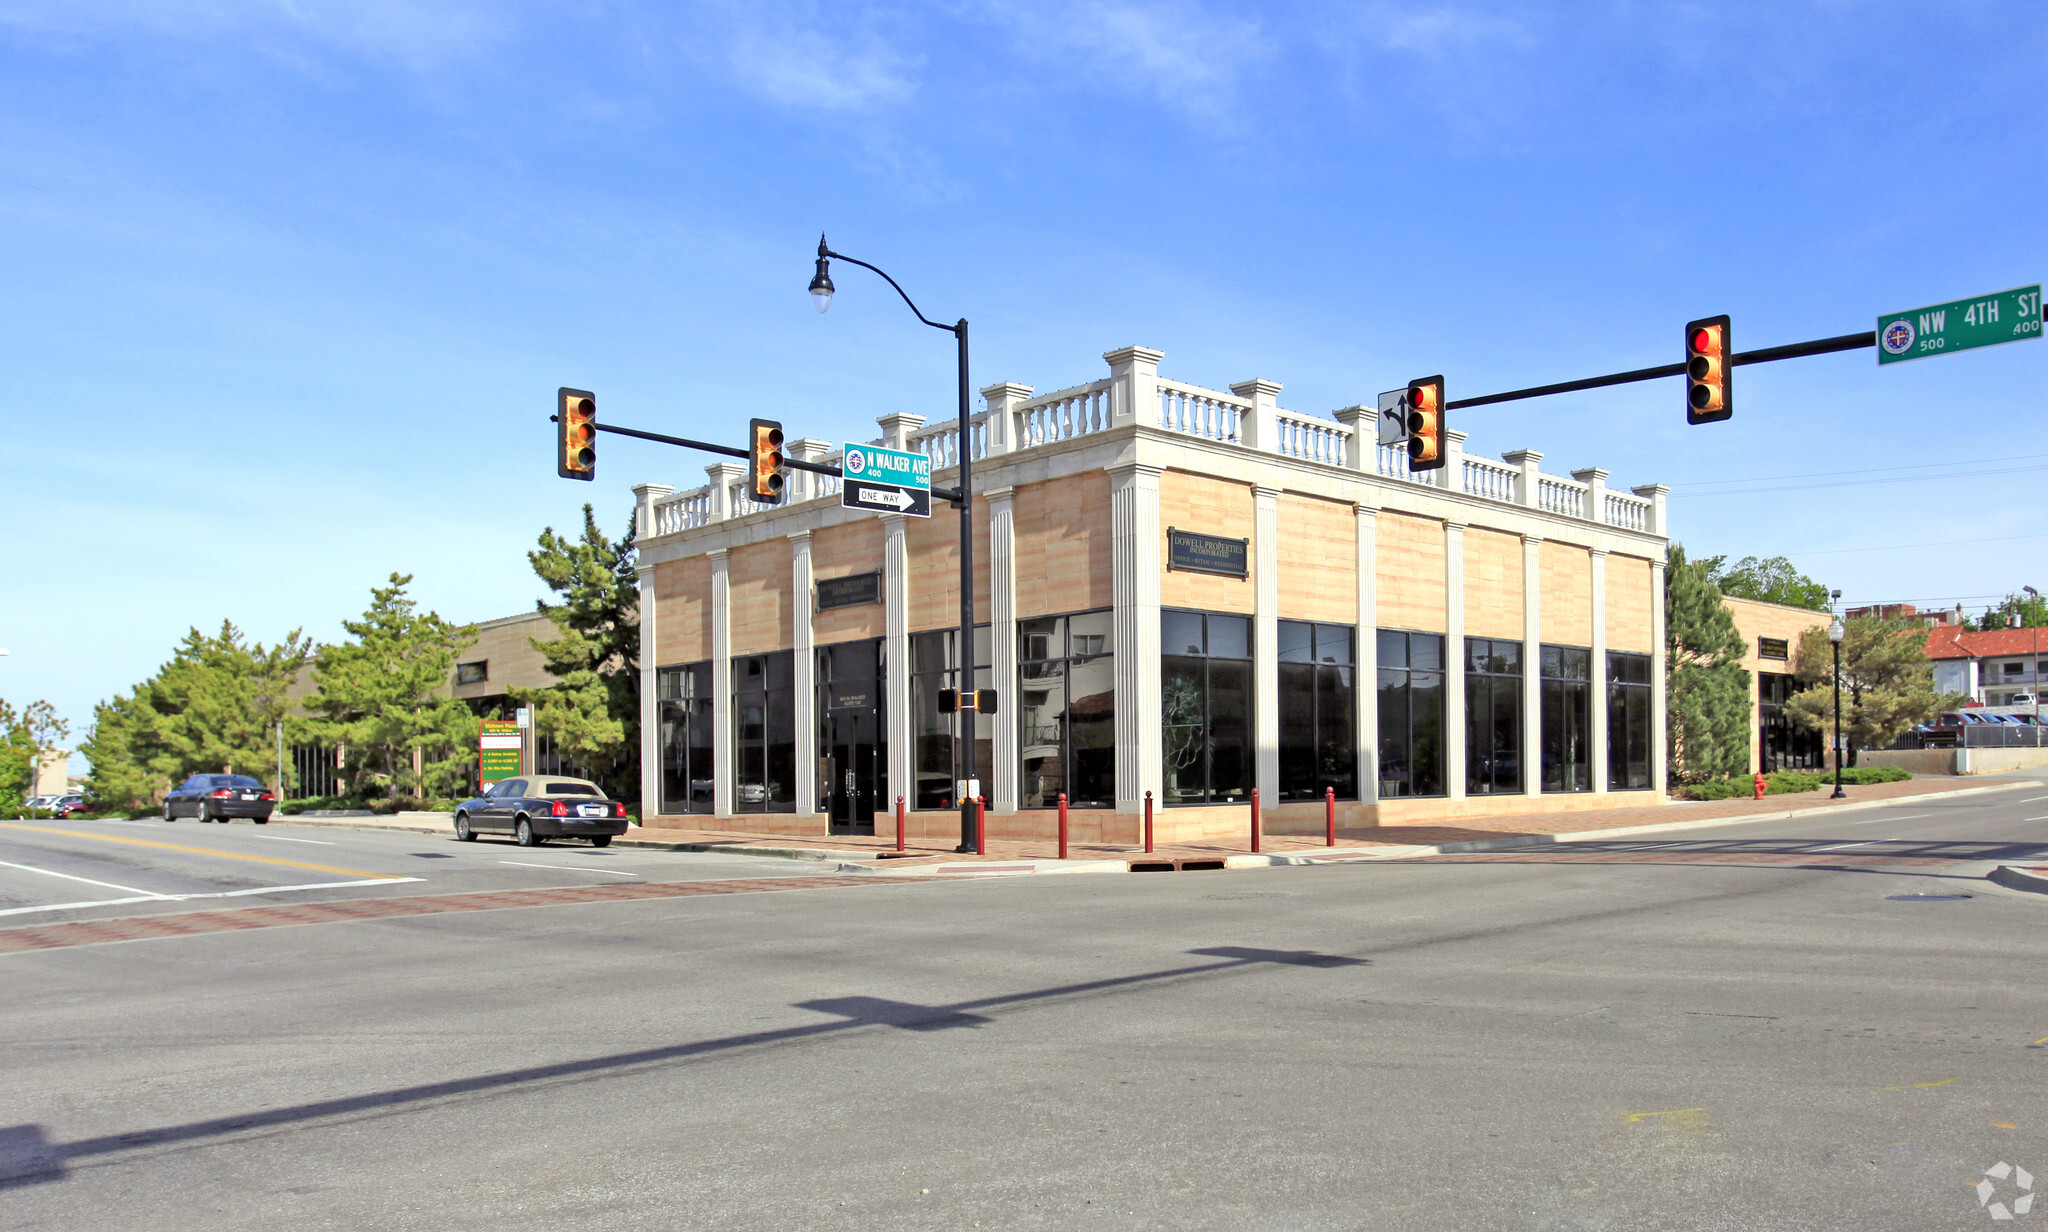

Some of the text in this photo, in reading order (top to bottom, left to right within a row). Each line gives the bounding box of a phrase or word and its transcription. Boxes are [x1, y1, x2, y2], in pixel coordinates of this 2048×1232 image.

[1919, 292, 2039, 336] NW 4TH ST
[2013, 320, 2040, 334] 400
[1920, 337, 1945, 352] 500
[867, 451, 929, 476] N WALKER AVE
[867, 469, 882, 478] 400
[915, 476, 929, 484] 500
[861, 490, 899, 504] ONE WAY
[1175, 536, 1243, 555] DOWELL PROPERTIES
[1190, 546, 1229, 558] INCORPORATED
[1174, 555, 1190, 563] OFFICE
